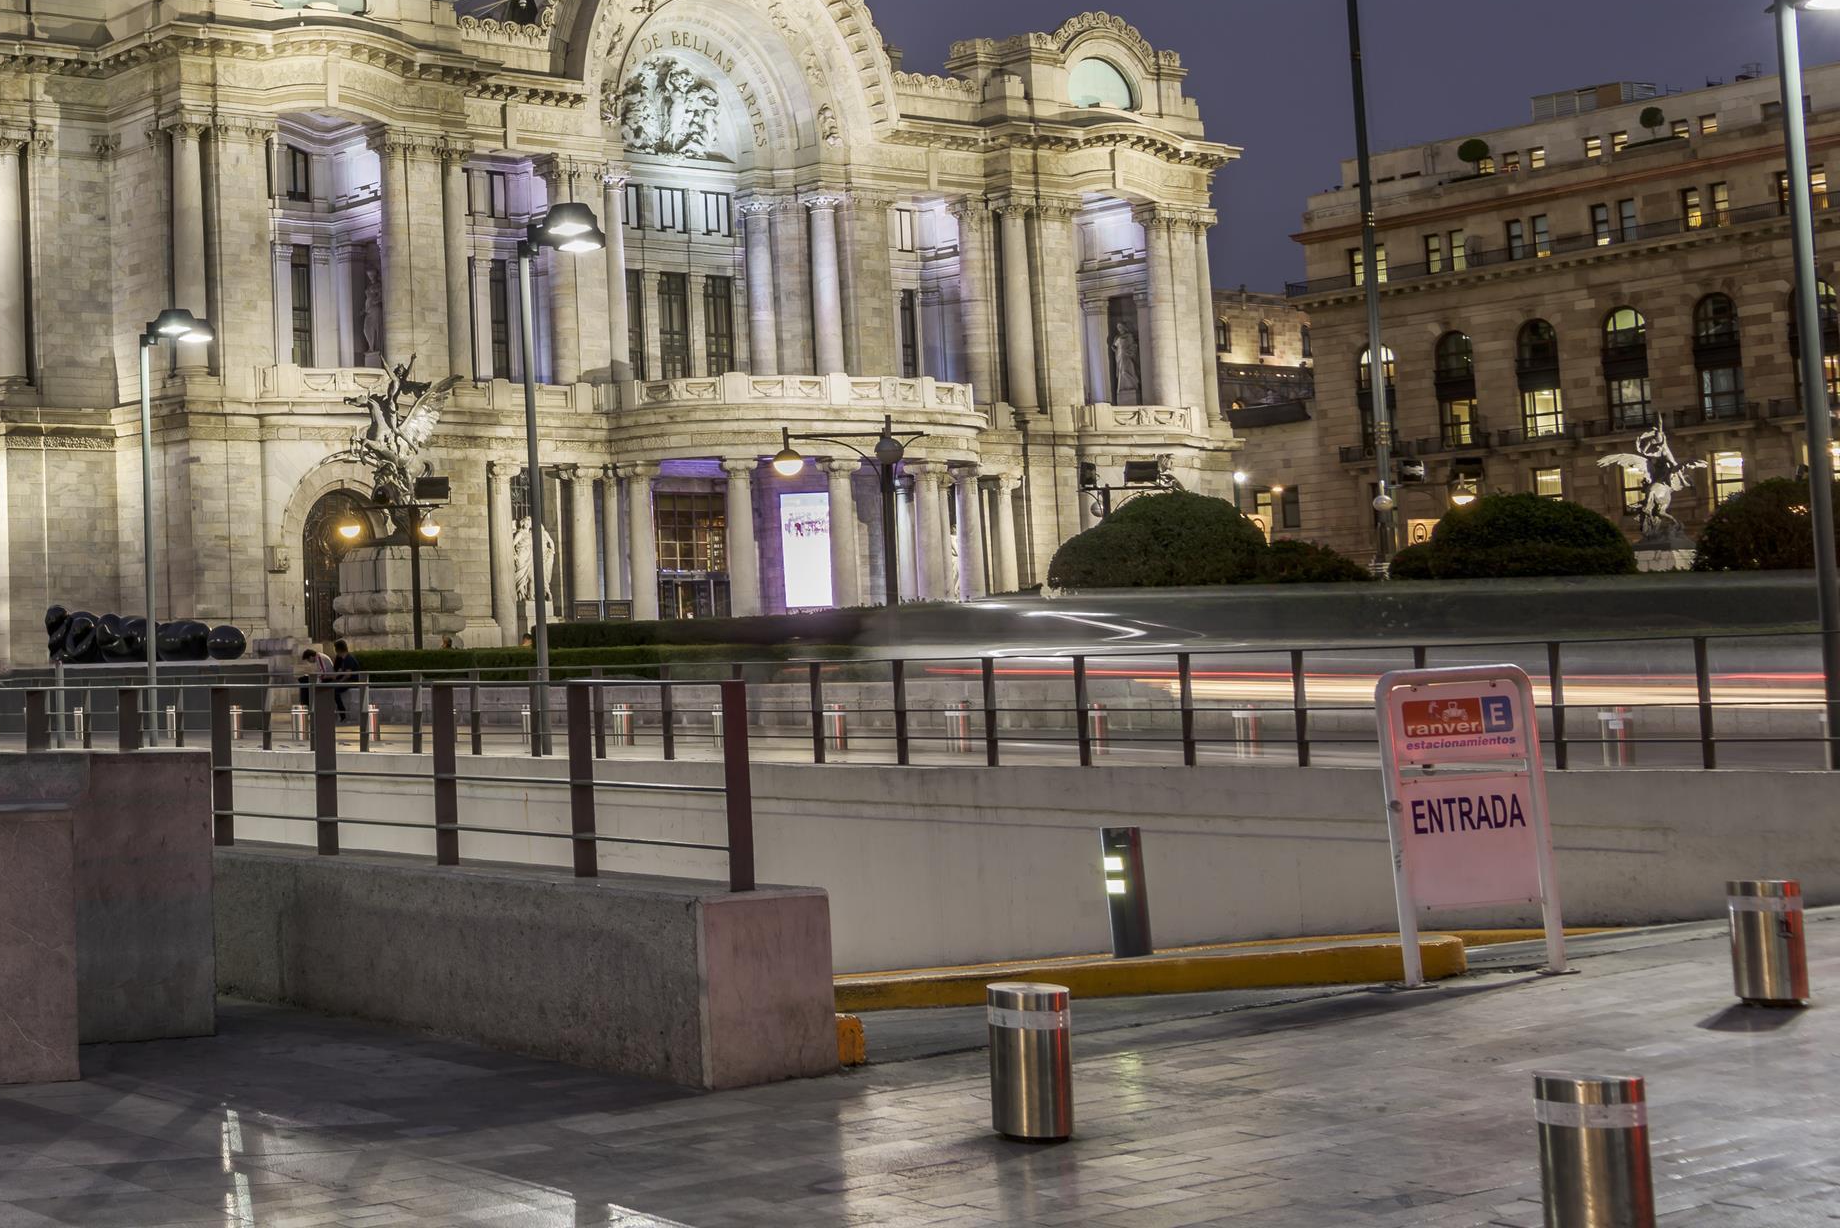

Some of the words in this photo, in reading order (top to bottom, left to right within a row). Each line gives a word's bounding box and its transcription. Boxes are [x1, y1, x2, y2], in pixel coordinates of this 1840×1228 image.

[640, 32, 663, 54] DE
[671, 30, 736, 74] BELLAS
[737, 81, 767, 148] ARTES
[1489, 702, 1506, 726] E
[1406, 735, 1517, 751] estacionamientos
[1411, 793, 1527, 835] ENTRADA
